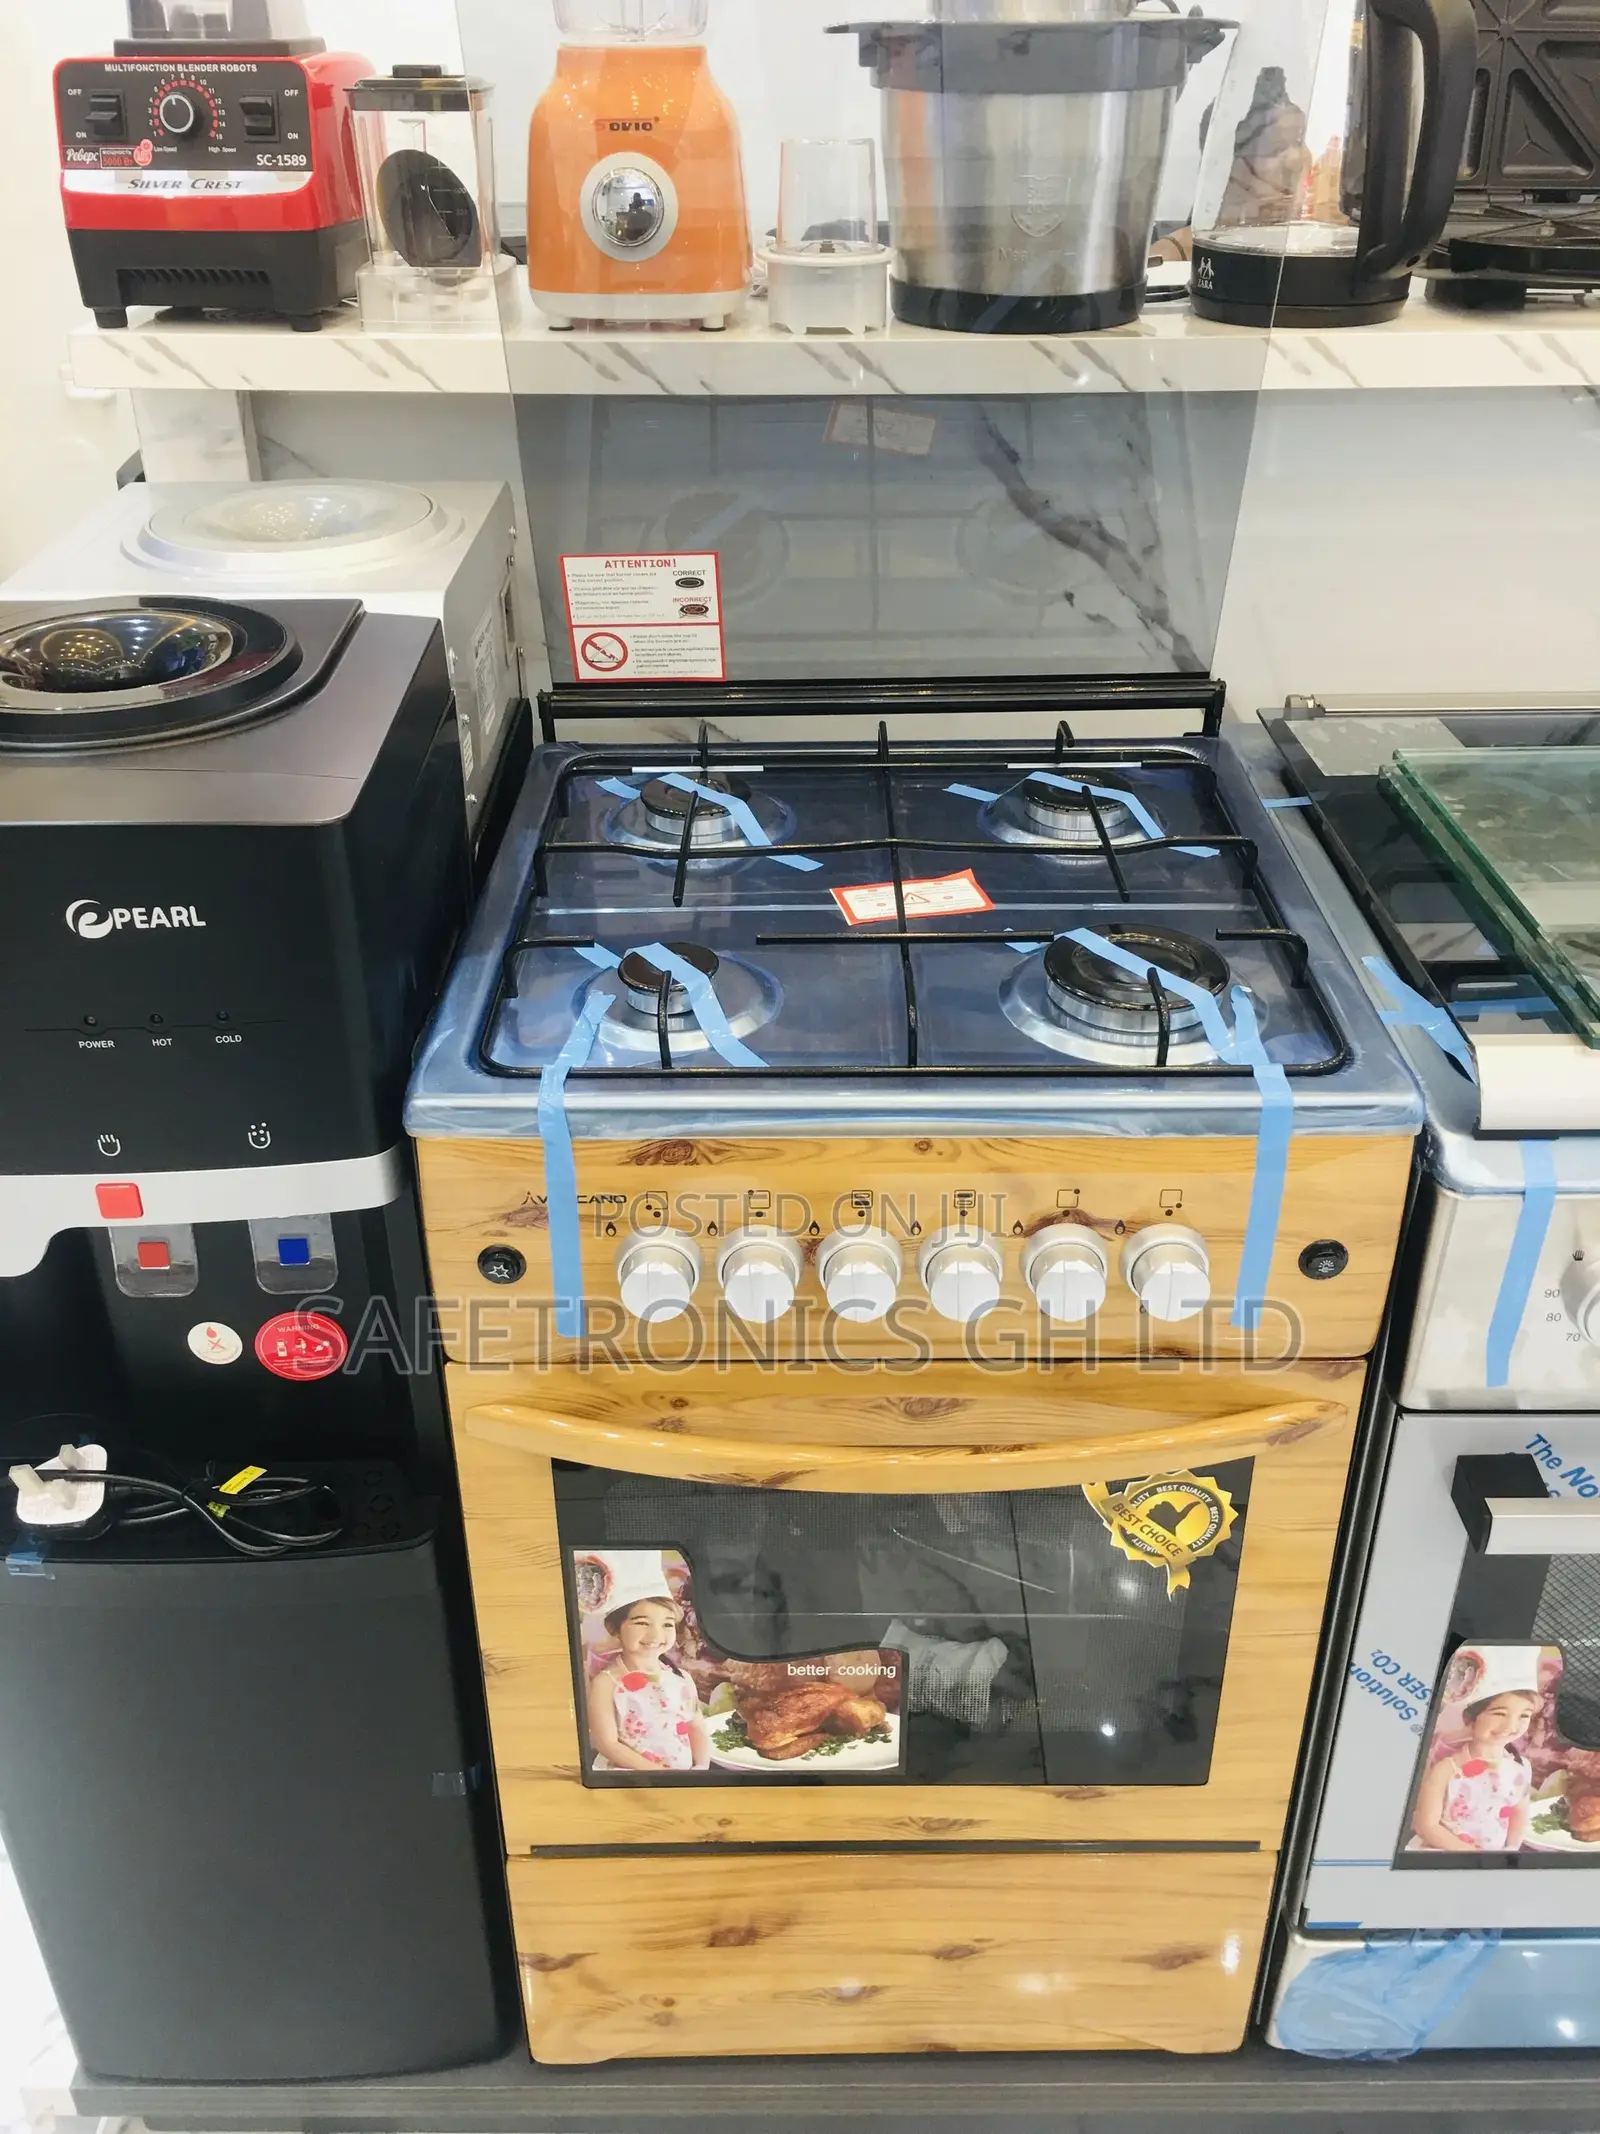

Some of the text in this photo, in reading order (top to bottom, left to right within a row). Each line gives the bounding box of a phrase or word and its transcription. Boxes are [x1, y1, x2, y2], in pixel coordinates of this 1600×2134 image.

[104, 64, 258, 72] MULTIFONCTION BLENDER ROBOTS
[284, 89, 299, 97] OFF
[287, 132, 299, 140] ON
[208, 146, 220, 154] High
[256, 154, 307, 167] SC-1589
[604, 558, 676, 568] ATTENTION!
[112, 906, 206, 930] PEARL
[152, 1038, 172, 1047] HOT
[215, 1034, 242, 1044] COLD
[78, 1040, 115, 1049] POWER
[537, 1195, 627, 1204] VCANO
[1544, 1288, 1560, 1298] 90
[1546, 1312, 1562, 1322] 80
[277, 1324, 320, 1333] WARNING
[1566, 1332, 1580, 1342] 70
[1526, 1433, 1562, 1470] The
[1156, 1484, 1213, 1504] BEST QUALITY
[1112, 1502, 1183, 1557] BEST CHOICE
[1192, 1506, 1218, 1548] BEST QUALITY
[788, 1664, 896, 1678] better cooking
